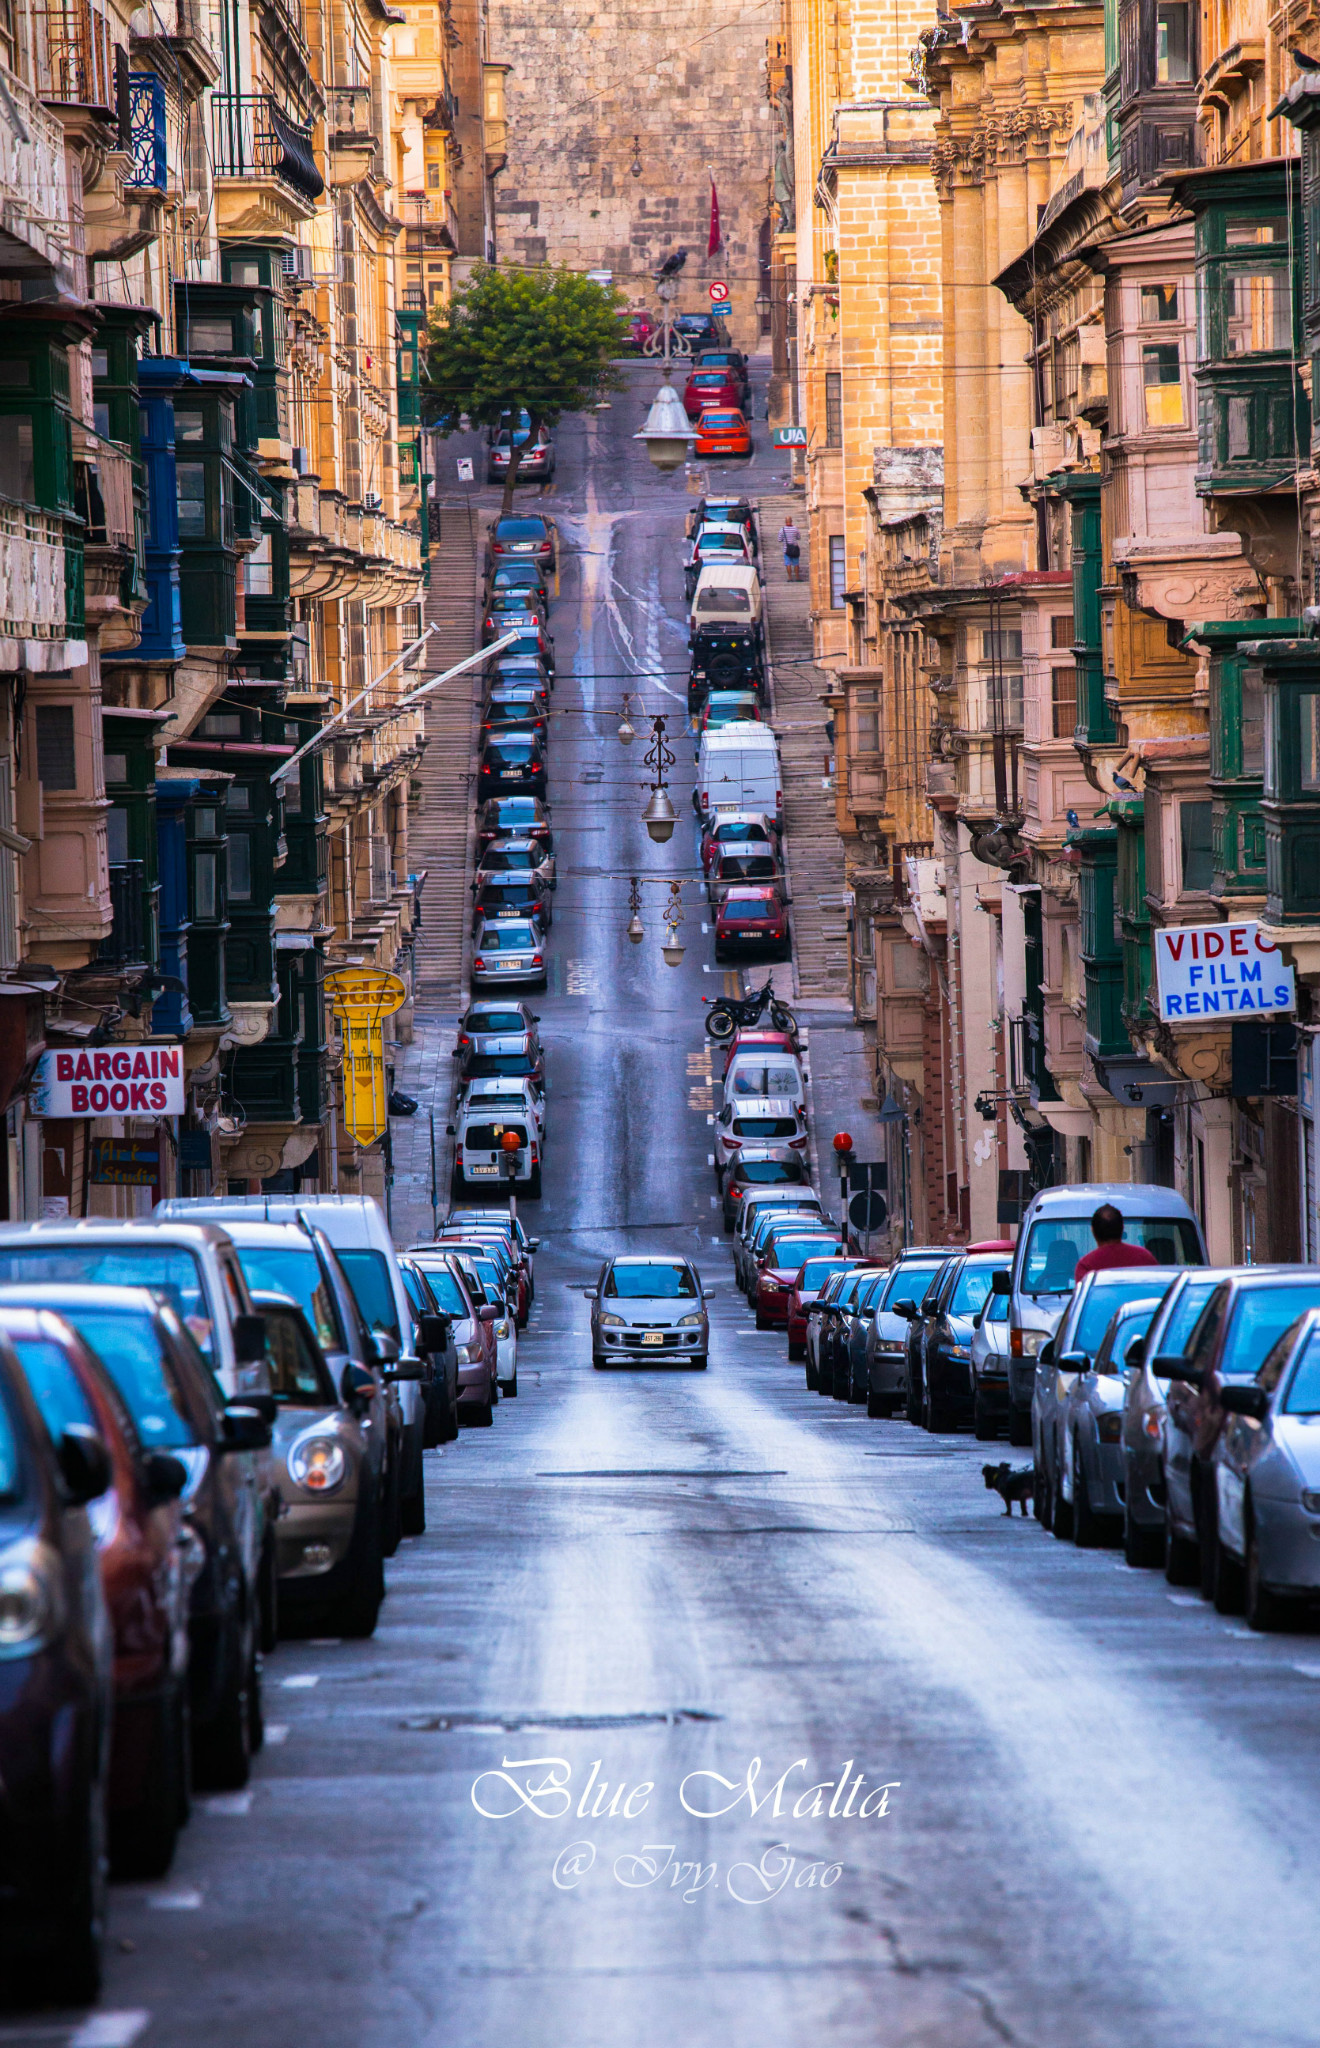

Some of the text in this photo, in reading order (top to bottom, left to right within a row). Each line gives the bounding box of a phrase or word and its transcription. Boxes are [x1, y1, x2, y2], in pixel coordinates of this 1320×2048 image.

[1189, 960, 1262, 987] FILM
[1166, 985, 1290, 1015] RENTALS
[57, 1051, 179, 1081] BARGAIN
[71, 1082, 168, 1112] BOOKS
[100, 1140, 141, 1161] Art
[104, 1166, 156, 1184] Studio
